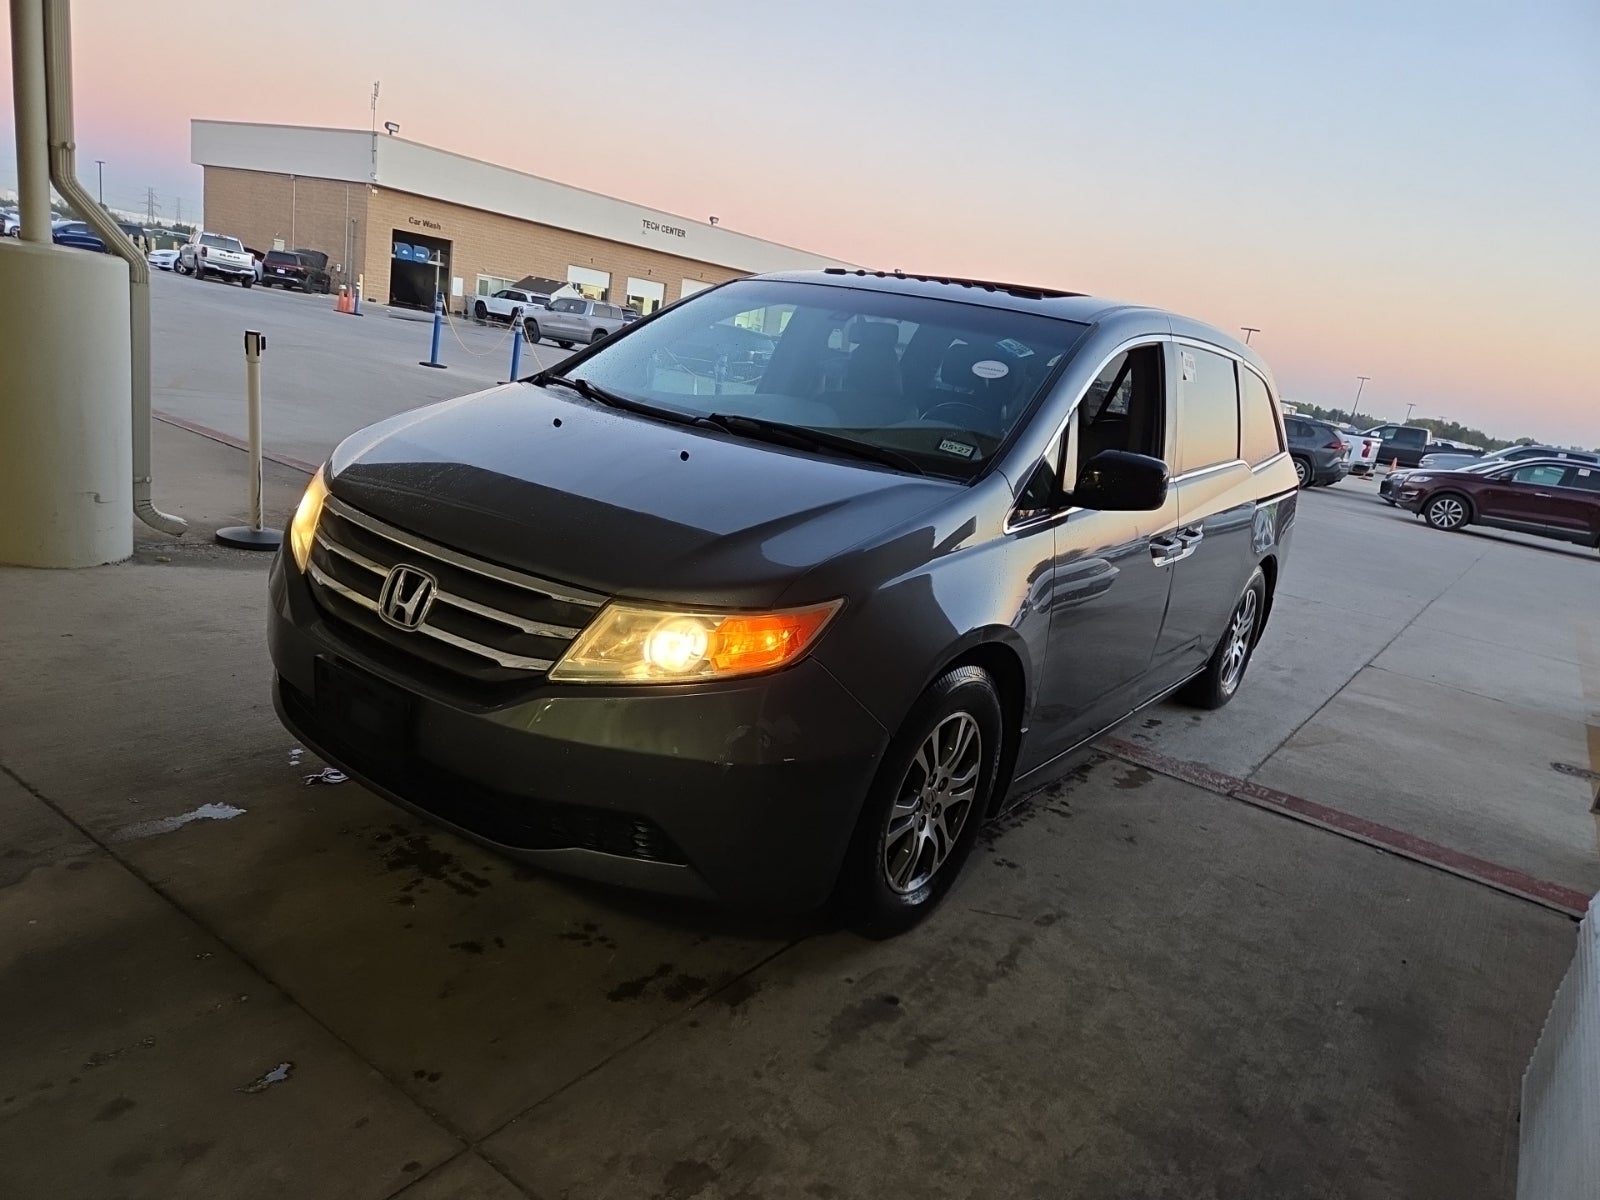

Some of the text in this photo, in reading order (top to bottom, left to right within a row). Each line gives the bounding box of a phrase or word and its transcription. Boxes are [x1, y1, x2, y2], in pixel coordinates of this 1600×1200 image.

[408, 216, 441, 230] Car Wash
[642, 219, 686, 238] TECH CENTER
